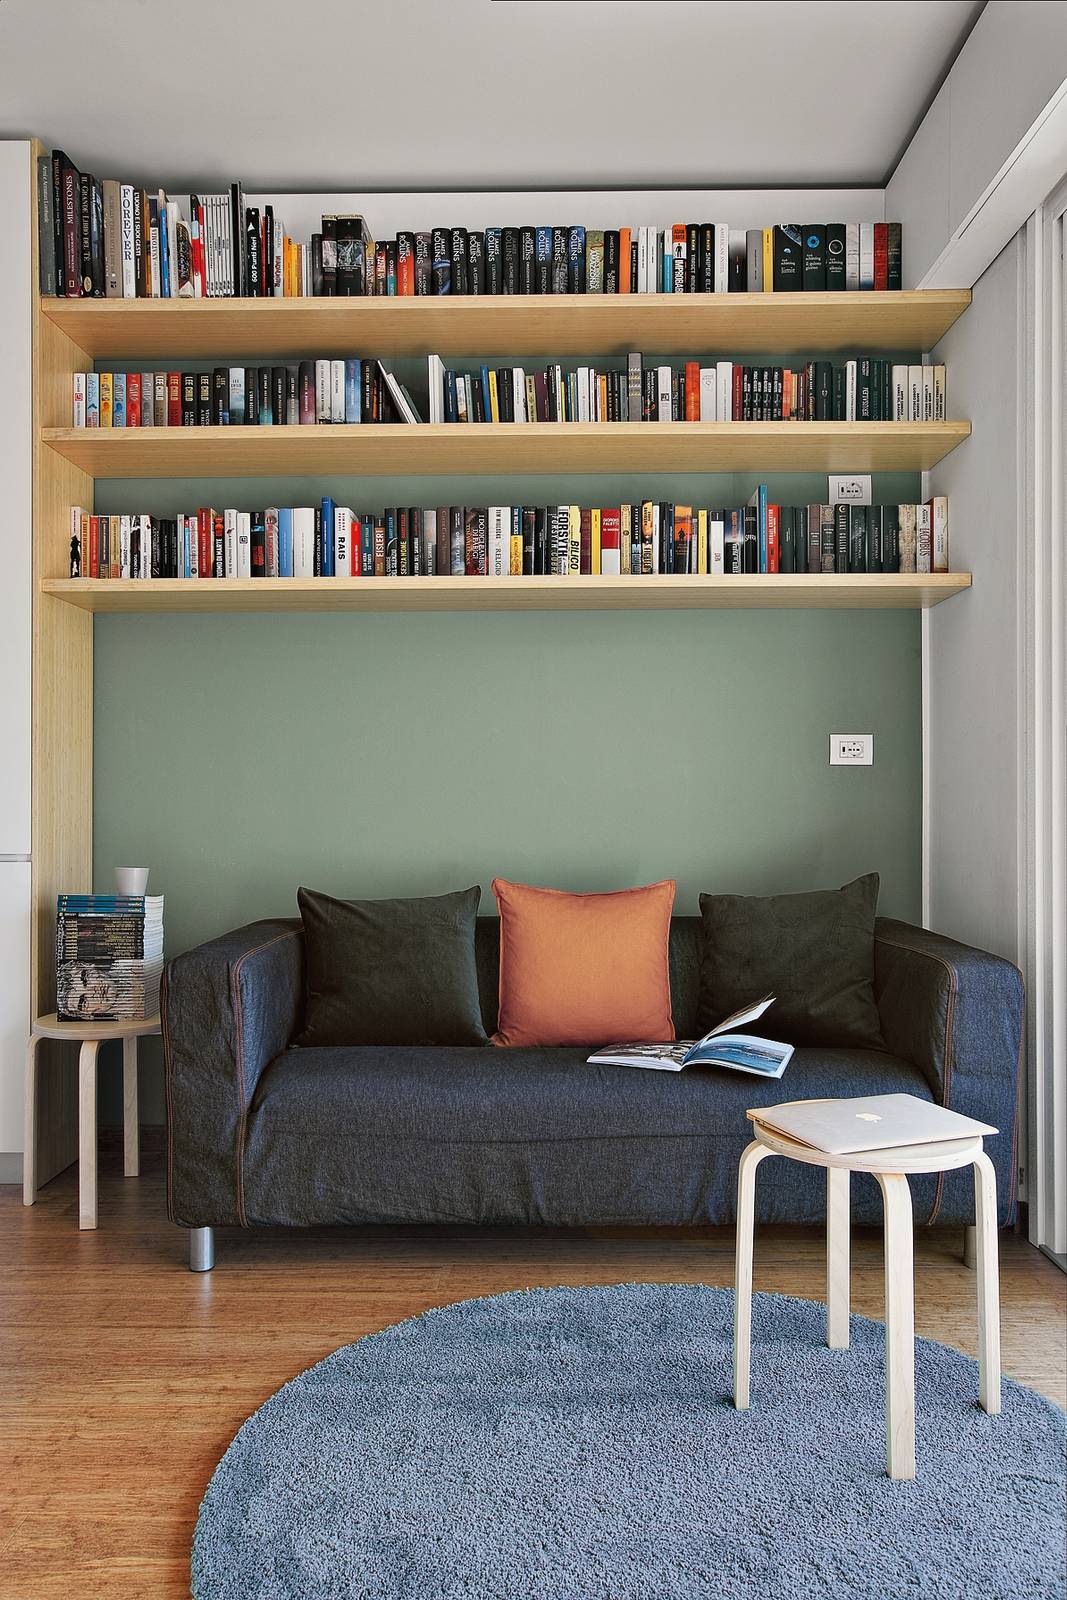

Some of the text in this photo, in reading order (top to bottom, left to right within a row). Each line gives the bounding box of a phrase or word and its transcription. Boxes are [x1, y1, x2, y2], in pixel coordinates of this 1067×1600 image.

[65, 175, 74, 224] MILESTONES
[123, 188, 132, 260] FOREVER
[558, 512, 568, 556] FORSYTH
[571, 540, 579, 570] BILICO
[920, 528, 930, 556] IACOBUS
